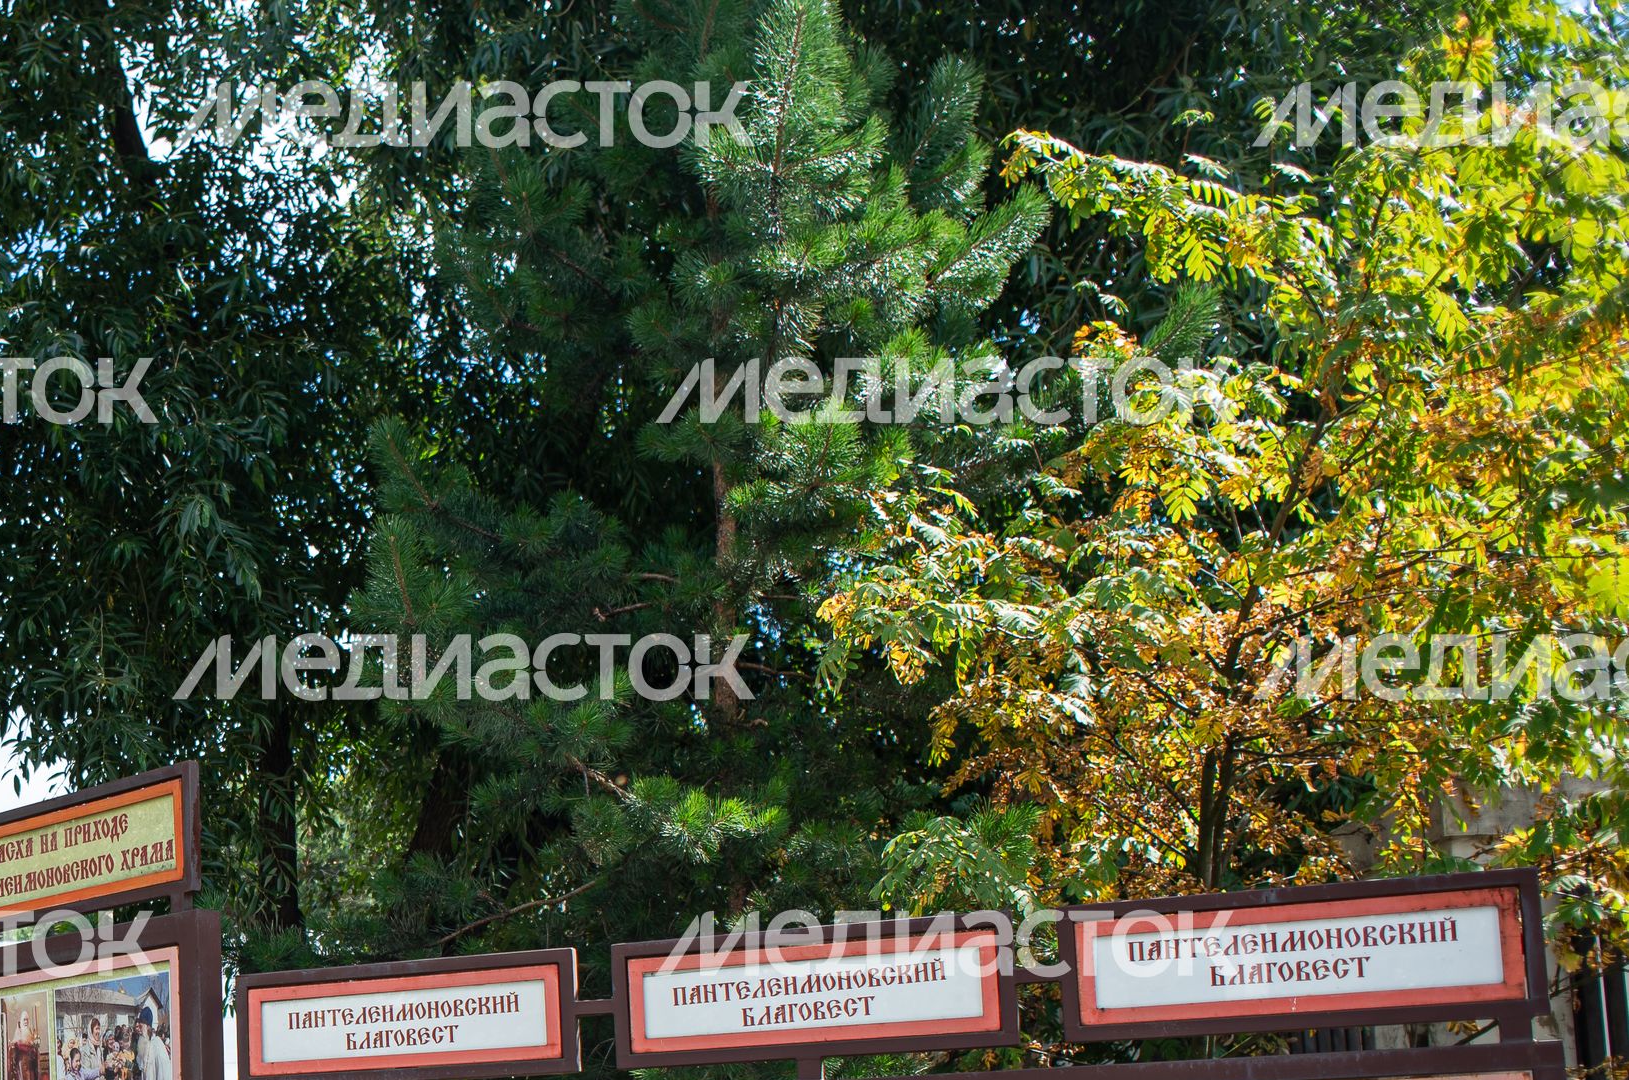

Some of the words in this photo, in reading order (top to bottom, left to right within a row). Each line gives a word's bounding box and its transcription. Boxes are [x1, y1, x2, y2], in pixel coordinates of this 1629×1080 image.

[40, 831, 58, 854] НА
[64, 813, 129, 846] ПРИХОДЕ
[120, 839, 174, 871] ХРАМА
[1209, 956, 1370, 987] БЛАГОВЕСТ
[741, 995, 875, 1027] БЛАГОВЕСТ
[346, 1024, 459, 1051] БЛАГОВЕСТ
